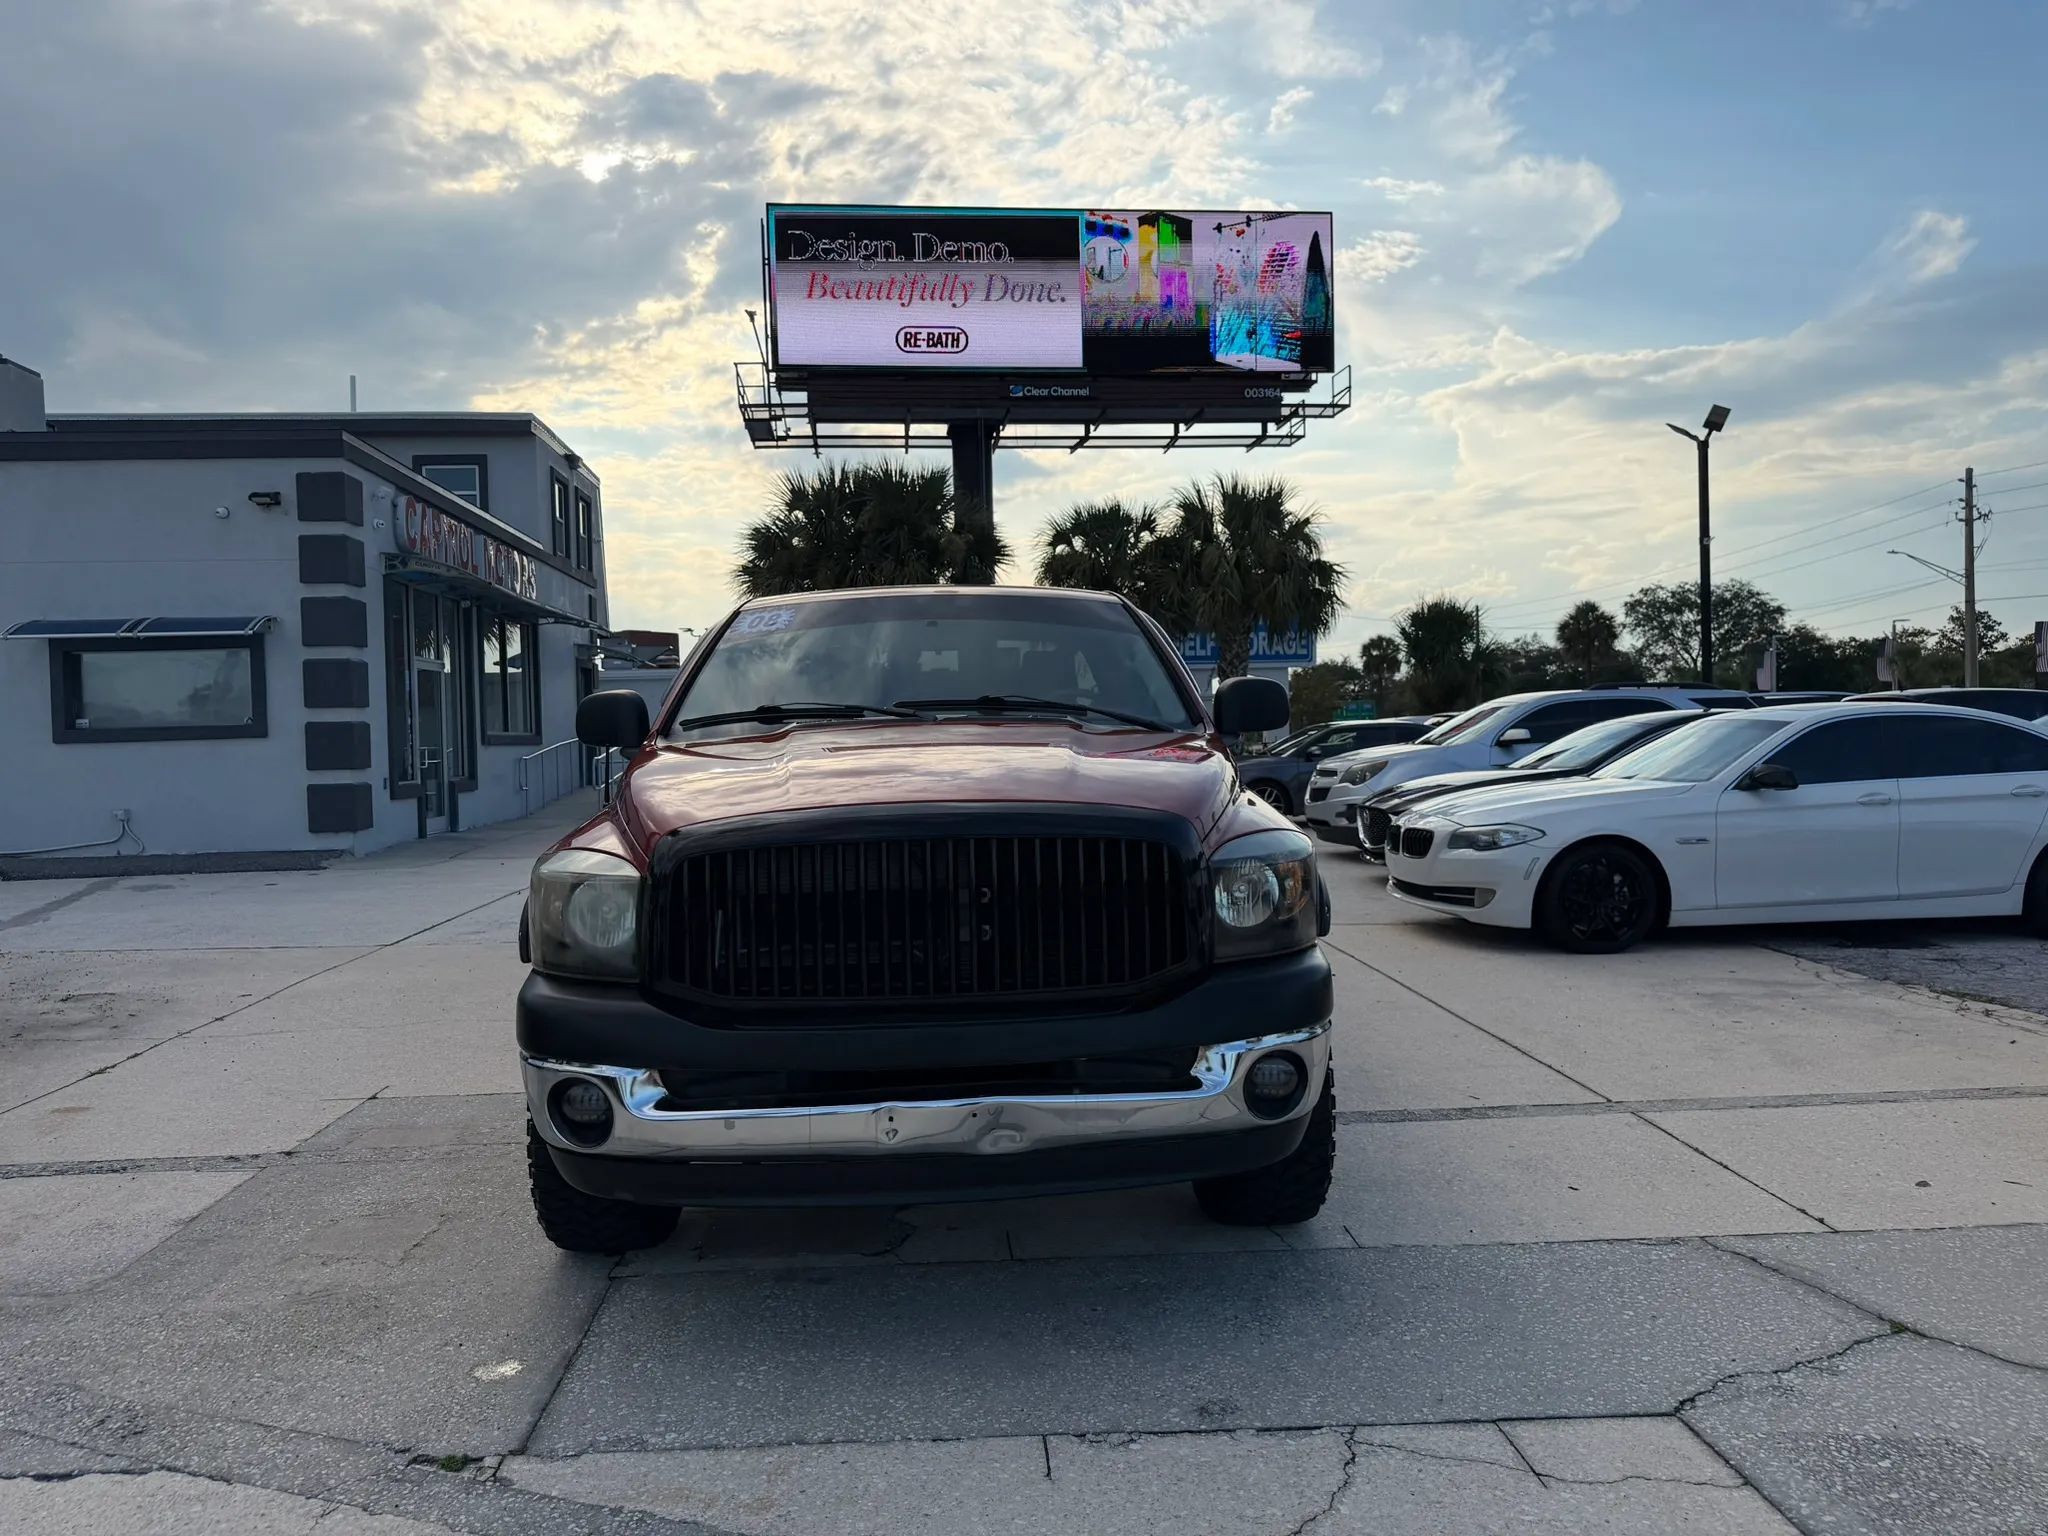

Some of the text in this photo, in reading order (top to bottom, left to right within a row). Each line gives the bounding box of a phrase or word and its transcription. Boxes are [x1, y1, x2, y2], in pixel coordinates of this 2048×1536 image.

[787, 230, 1015, 270] Design. Demo.
[807, 271, 1066, 308] Beautifully Done.
[903, 331, 961, 348] RE-BATH
[1024, 386, 1090, 396] Clear Channel
[1244, 388, 1280, 398] 003164
[404, 499, 537, 600] CAPITOL MOTORS
[1249, 631, 1308, 656] ORAGE
